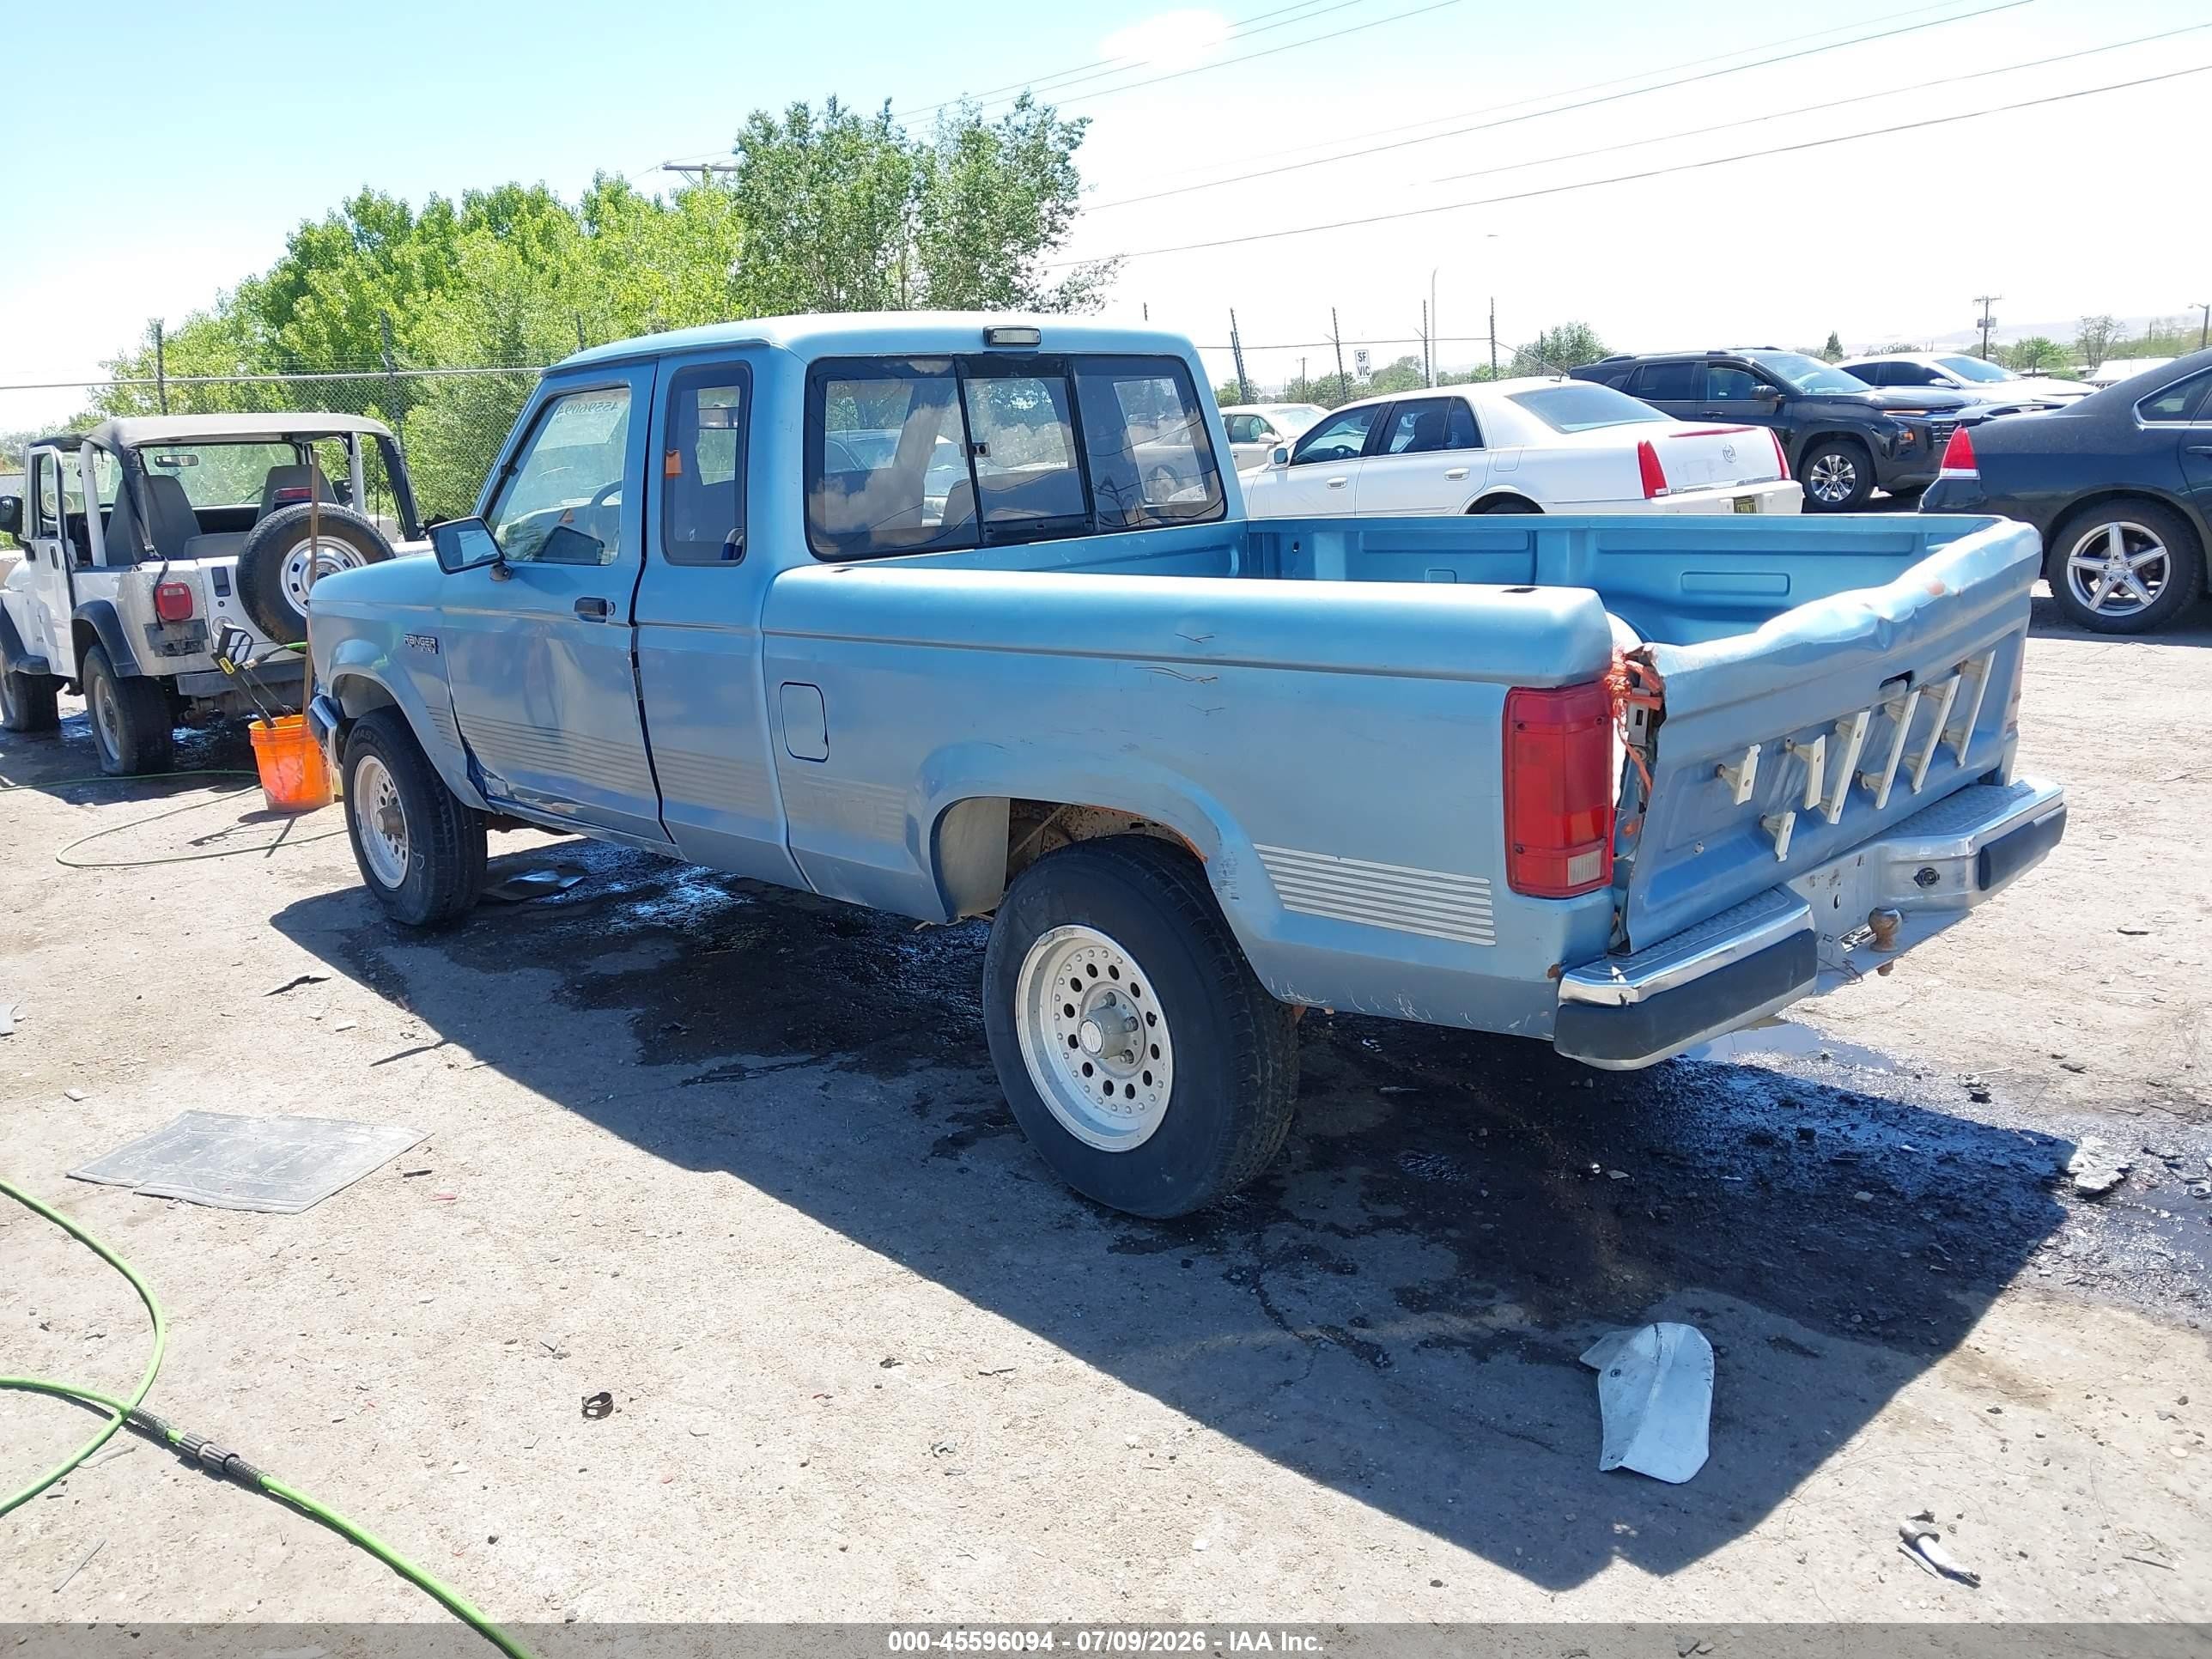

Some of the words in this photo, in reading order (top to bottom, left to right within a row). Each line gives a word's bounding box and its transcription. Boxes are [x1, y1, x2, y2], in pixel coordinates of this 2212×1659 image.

[1358, 351, 1366, 362] SF
[1357, 365, 1370, 376] VIC
[404, 634, 436, 648] RANGER
